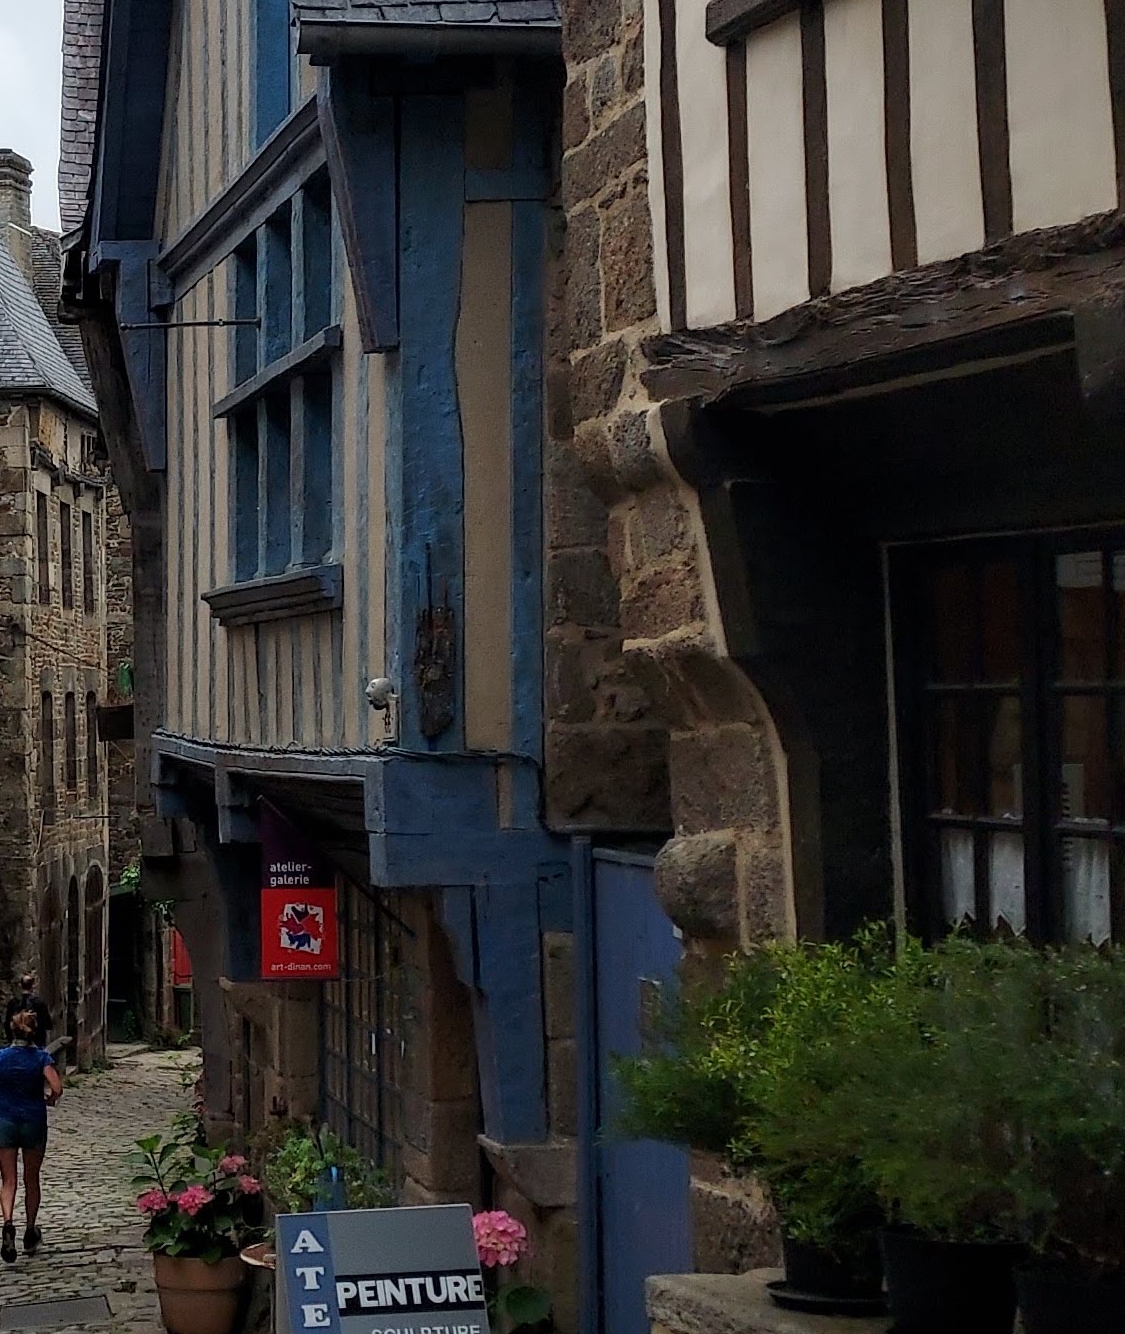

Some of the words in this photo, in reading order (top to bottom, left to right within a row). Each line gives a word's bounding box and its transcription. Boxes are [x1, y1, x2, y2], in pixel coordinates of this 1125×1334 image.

[270, 861, 312, 872] atelier-
[270, 874, 310, 887] galerie
[337, 1274, 485, 1309] PEINTURE
